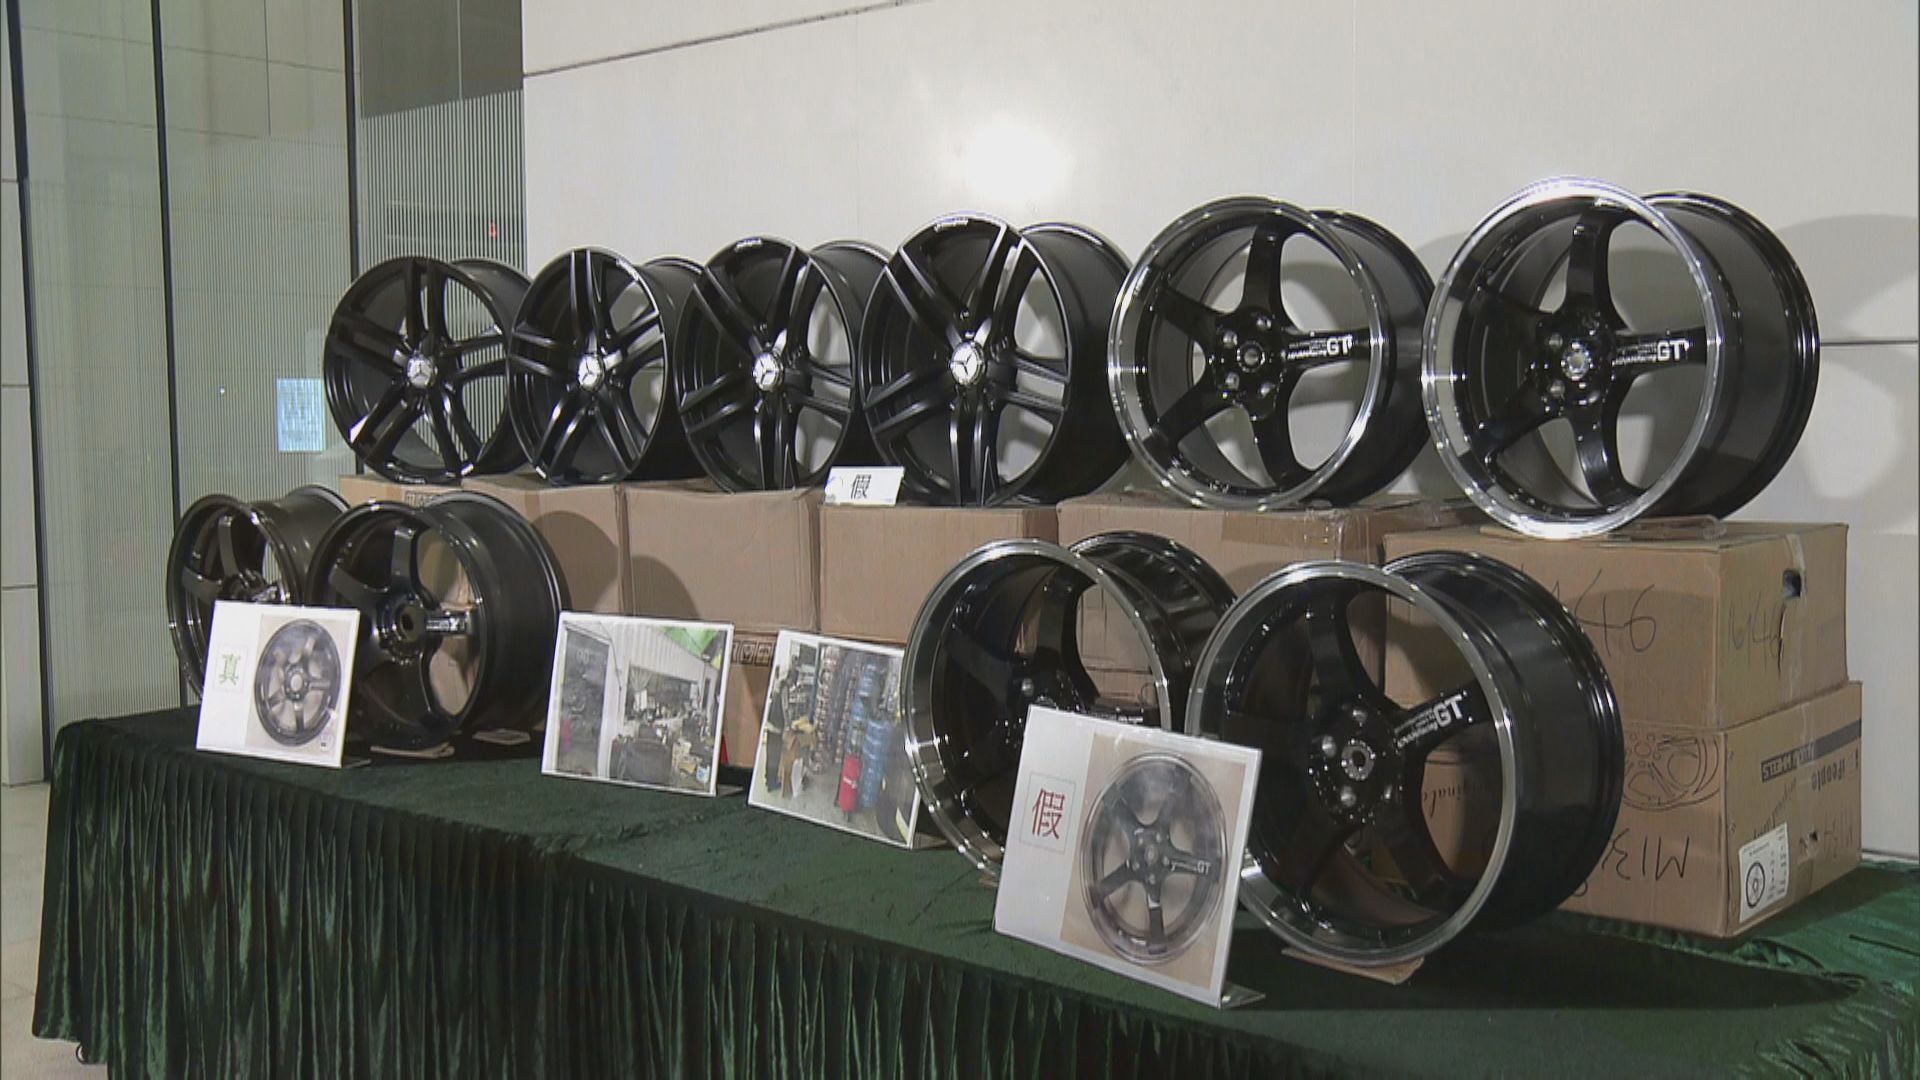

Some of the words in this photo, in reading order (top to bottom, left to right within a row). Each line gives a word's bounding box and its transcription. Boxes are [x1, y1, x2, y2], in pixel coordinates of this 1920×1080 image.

[1656, 338, 1688, 361] GT
[1433, 694, 1463, 727] GT
[1031, 788, 1066, 840] 假
